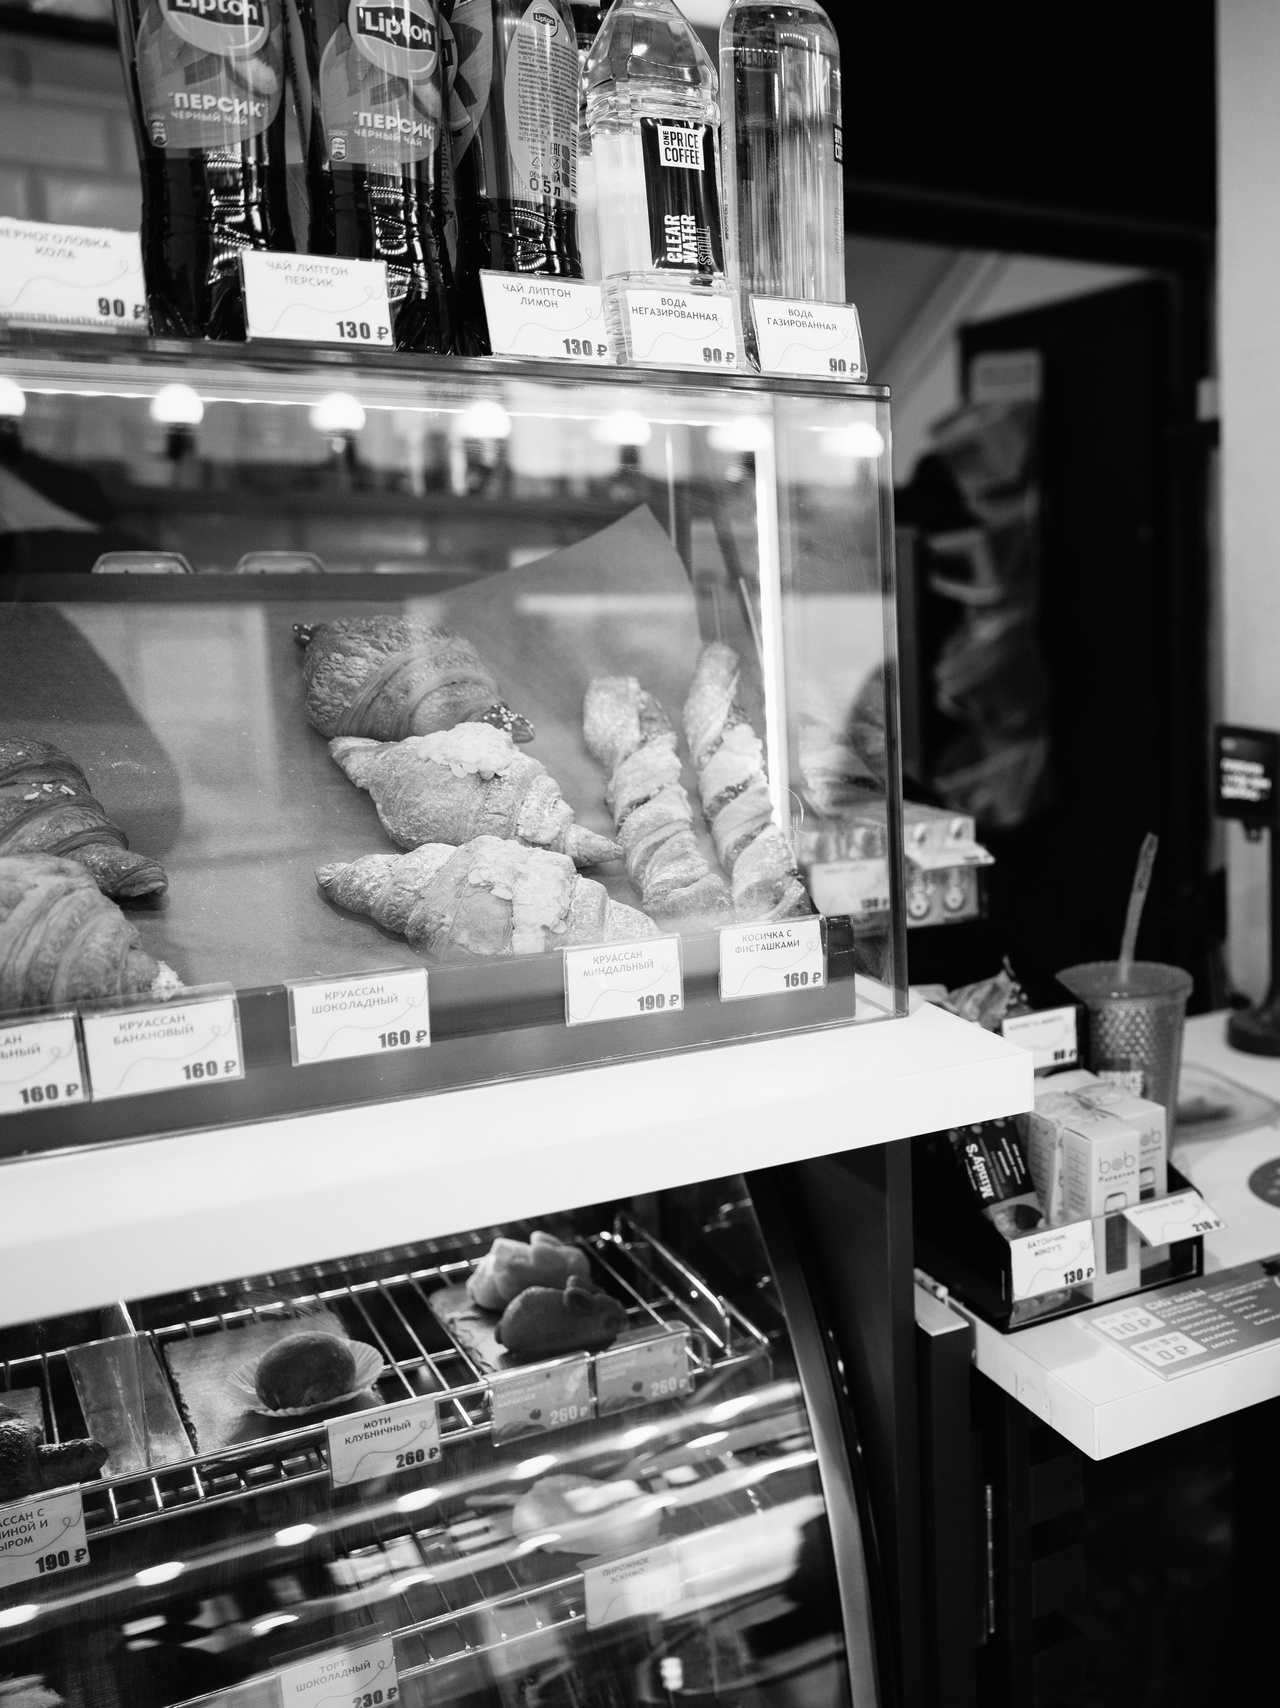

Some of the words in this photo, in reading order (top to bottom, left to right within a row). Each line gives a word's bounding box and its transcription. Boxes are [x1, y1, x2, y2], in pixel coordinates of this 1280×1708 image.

[364, 8, 433, 45] Lipton
[535, 14, 555, 25] Lipton
[669, 131, 699, 149] PRICE
[664, 147, 700, 165] COFFEE
[664, 214, 683, 263] CLEAR
[681, 214, 699, 264] WATER
[35, 246, 76, 259] КОЛА
[266, 260, 292, 271] ЧАЙ
[297, 263, 349, 277] ЛИПТОН
[285, 275, 334, 288] ПЕРСИК
[502, 283, 524, 293] ЧАЙ
[528, 286, 571, 298] ЛИПТОН
[98, 297, 125, 318] 90
[520, 297, 558, 308] ЛИМОН
[661, 297, 687, 309] ВОДА
[631, 306, 718, 322] НЕГАЗИРОВАННАЯ
[788, 308, 813, 319] ВОДА
[336, 320, 371, 340] 130
[767, 317, 837, 331] ГАЗИРОВАННАЯ
[563, 338, 593, 356] 130
[702, 347, 722, 363] 90
[829, 357, 847, 375] 90
[741, 930, 785, 943] КОСИЧКА
[786, 929, 792, 937] С
[735, 939, 800, 954] ФИСТАШКАМИ
[593, 950, 643, 965] КРУАССАН
[583, 959, 654, 978] МИНДАЛЬНЫЙ
[783, 971, 809, 988] 160
[325, 985, 384, 1001] КРУАССАН
[637, 993, 665, 1011] 190
[311, 993, 398, 1014] ШОКОЛАДНЫЙ
[119, 1014, 186, 1032] КРУАССАН
[113, 1025, 194, 1046] БАНАНОВЫЙ
[378, 1029, 410, 1048] 160
[181, 1060, 218, 1080] 160
[19, 1084, 59, 1104] 160
[1063, 1268, 1083, 1285] 130
[1110, 1321, 1139, 1336] 10
[1157, 1348, 1175, 1361] 0
[651, 1377, 677, 1397] 260
[363, 1417, 391, 1430] МОТИ
[551, 1405, 578, 1425] 260
[345, 1420, 411, 1445] КЛУБНИЧНЫЙ
[396, 1449, 425, 1468] 260
[37, 1508, 45, 1517] С
[40, 1519, 48, 1528] И
[35, 1550, 70, 1573] 190
[320, 1659, 346, 1673] ТОРТ
[296, 1660, 371, 1692] ШОКОЛАДНЫЙ
[352, 1690, 383, 1708] 230
